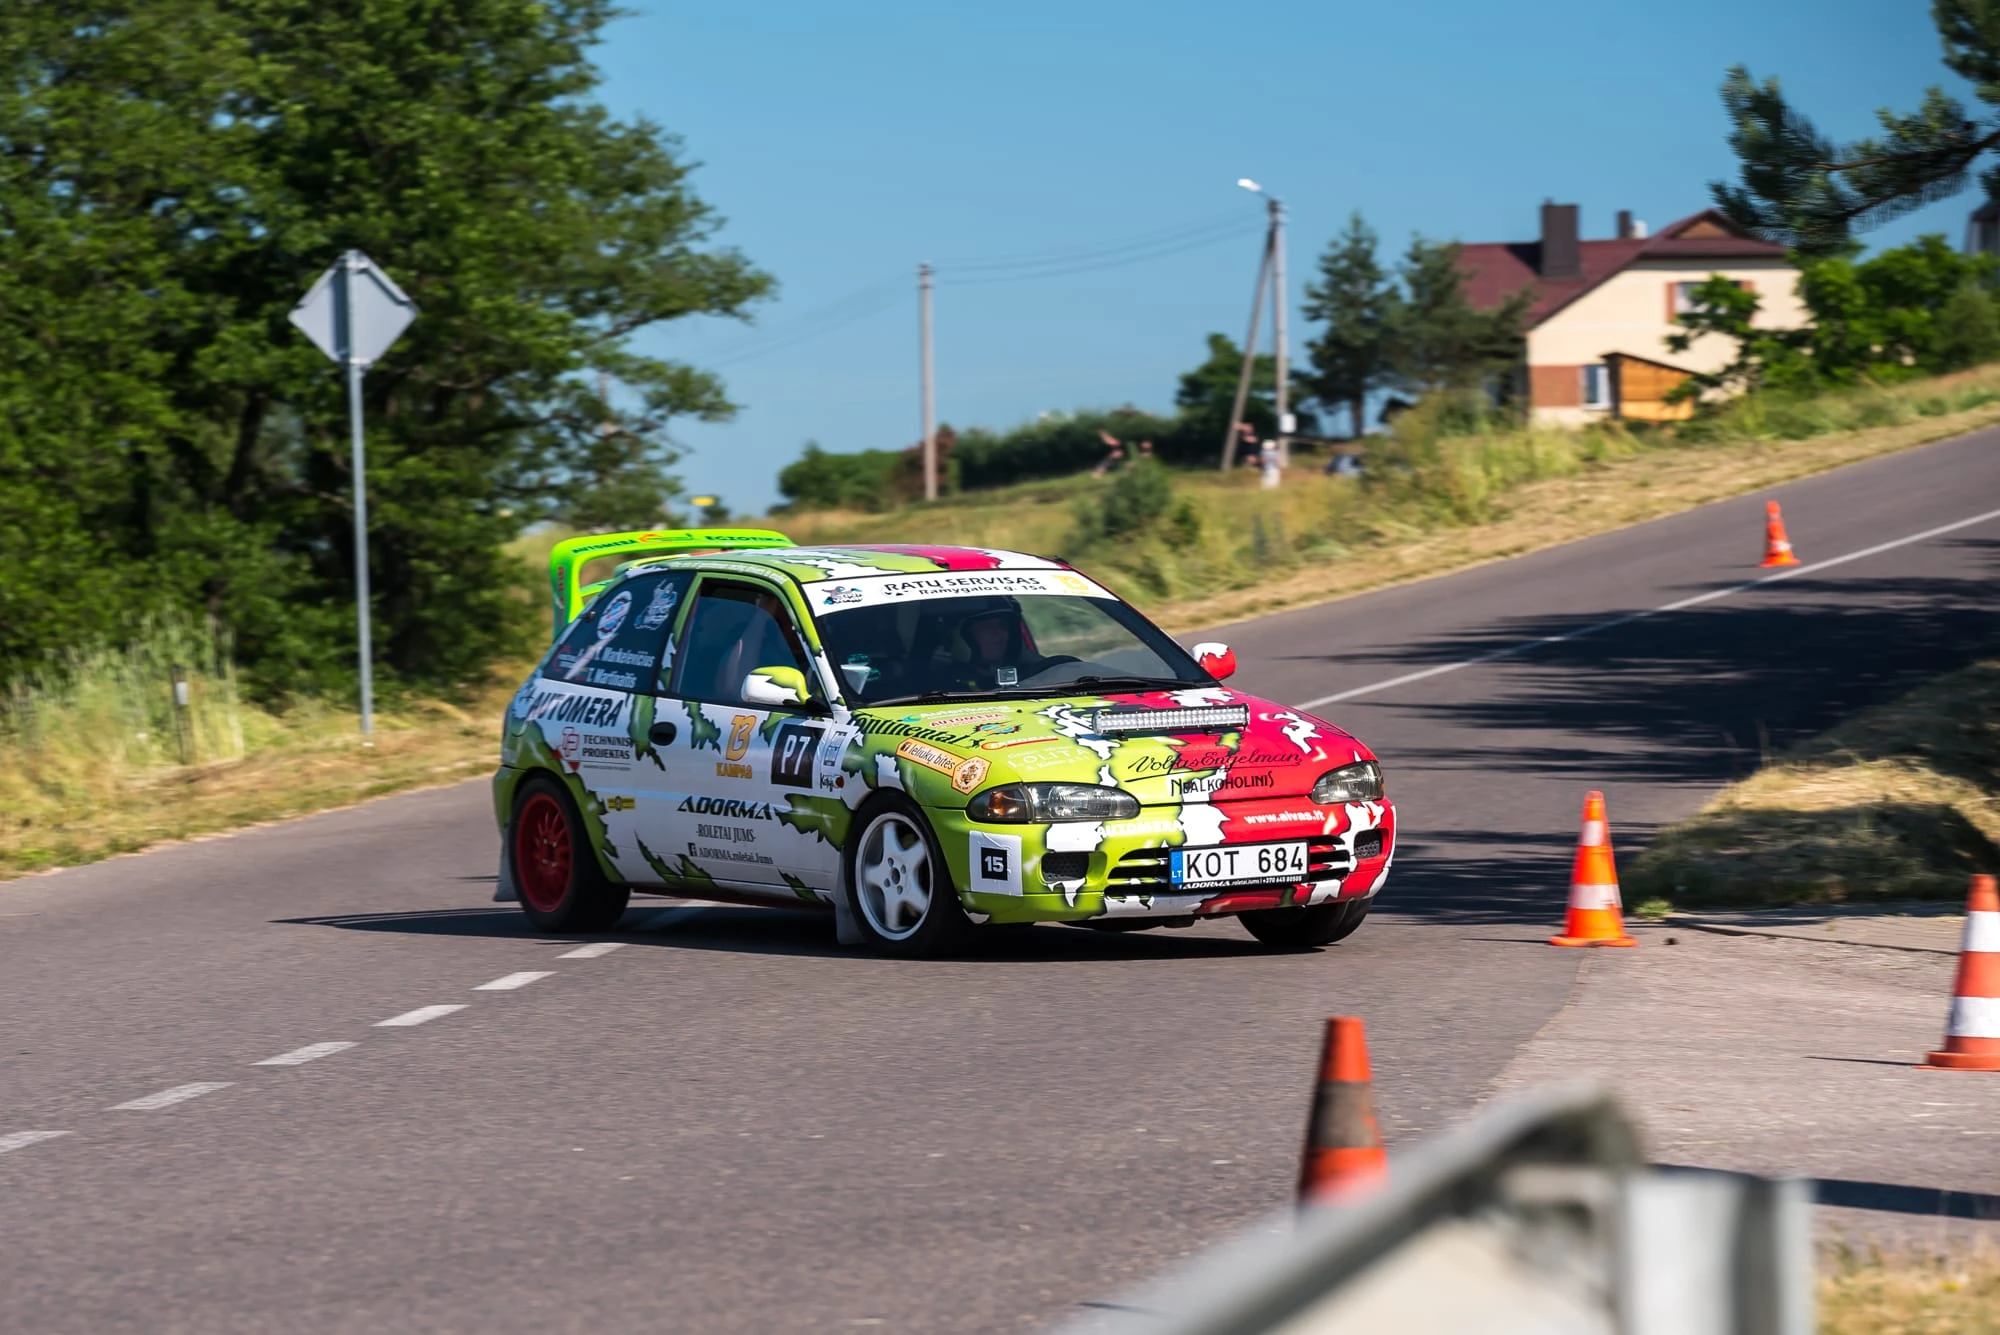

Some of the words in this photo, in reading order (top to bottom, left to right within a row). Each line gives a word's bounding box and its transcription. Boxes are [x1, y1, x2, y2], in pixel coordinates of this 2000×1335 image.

[919, 586, 1000, 595] Ramygalos
[945, 576, 1041, 587] SERVISAS
[527, 691, 624, 728] AUTOMERA
[583, 734, 633, 748] TECHNINIS
[582, 747, 630, 760] PROJEKTAS
[780, 734, 812, 776] P7
[1128, 754, 1200, 775] Volfas
[1201, 750, 1302, 773] Engelman
[1171, 770, 1274, 797] NEALKOHOLINIS
[677, 796, 773, 820] ADORMA
[984, 855, 1004, 873] 15
[1186, 850, 1239, 879] KOT
[1258, 846, 1303, 873] 684
[1171, 870, 1182, 878] LT
[1182, 880, 1230, 890] ADORMA
